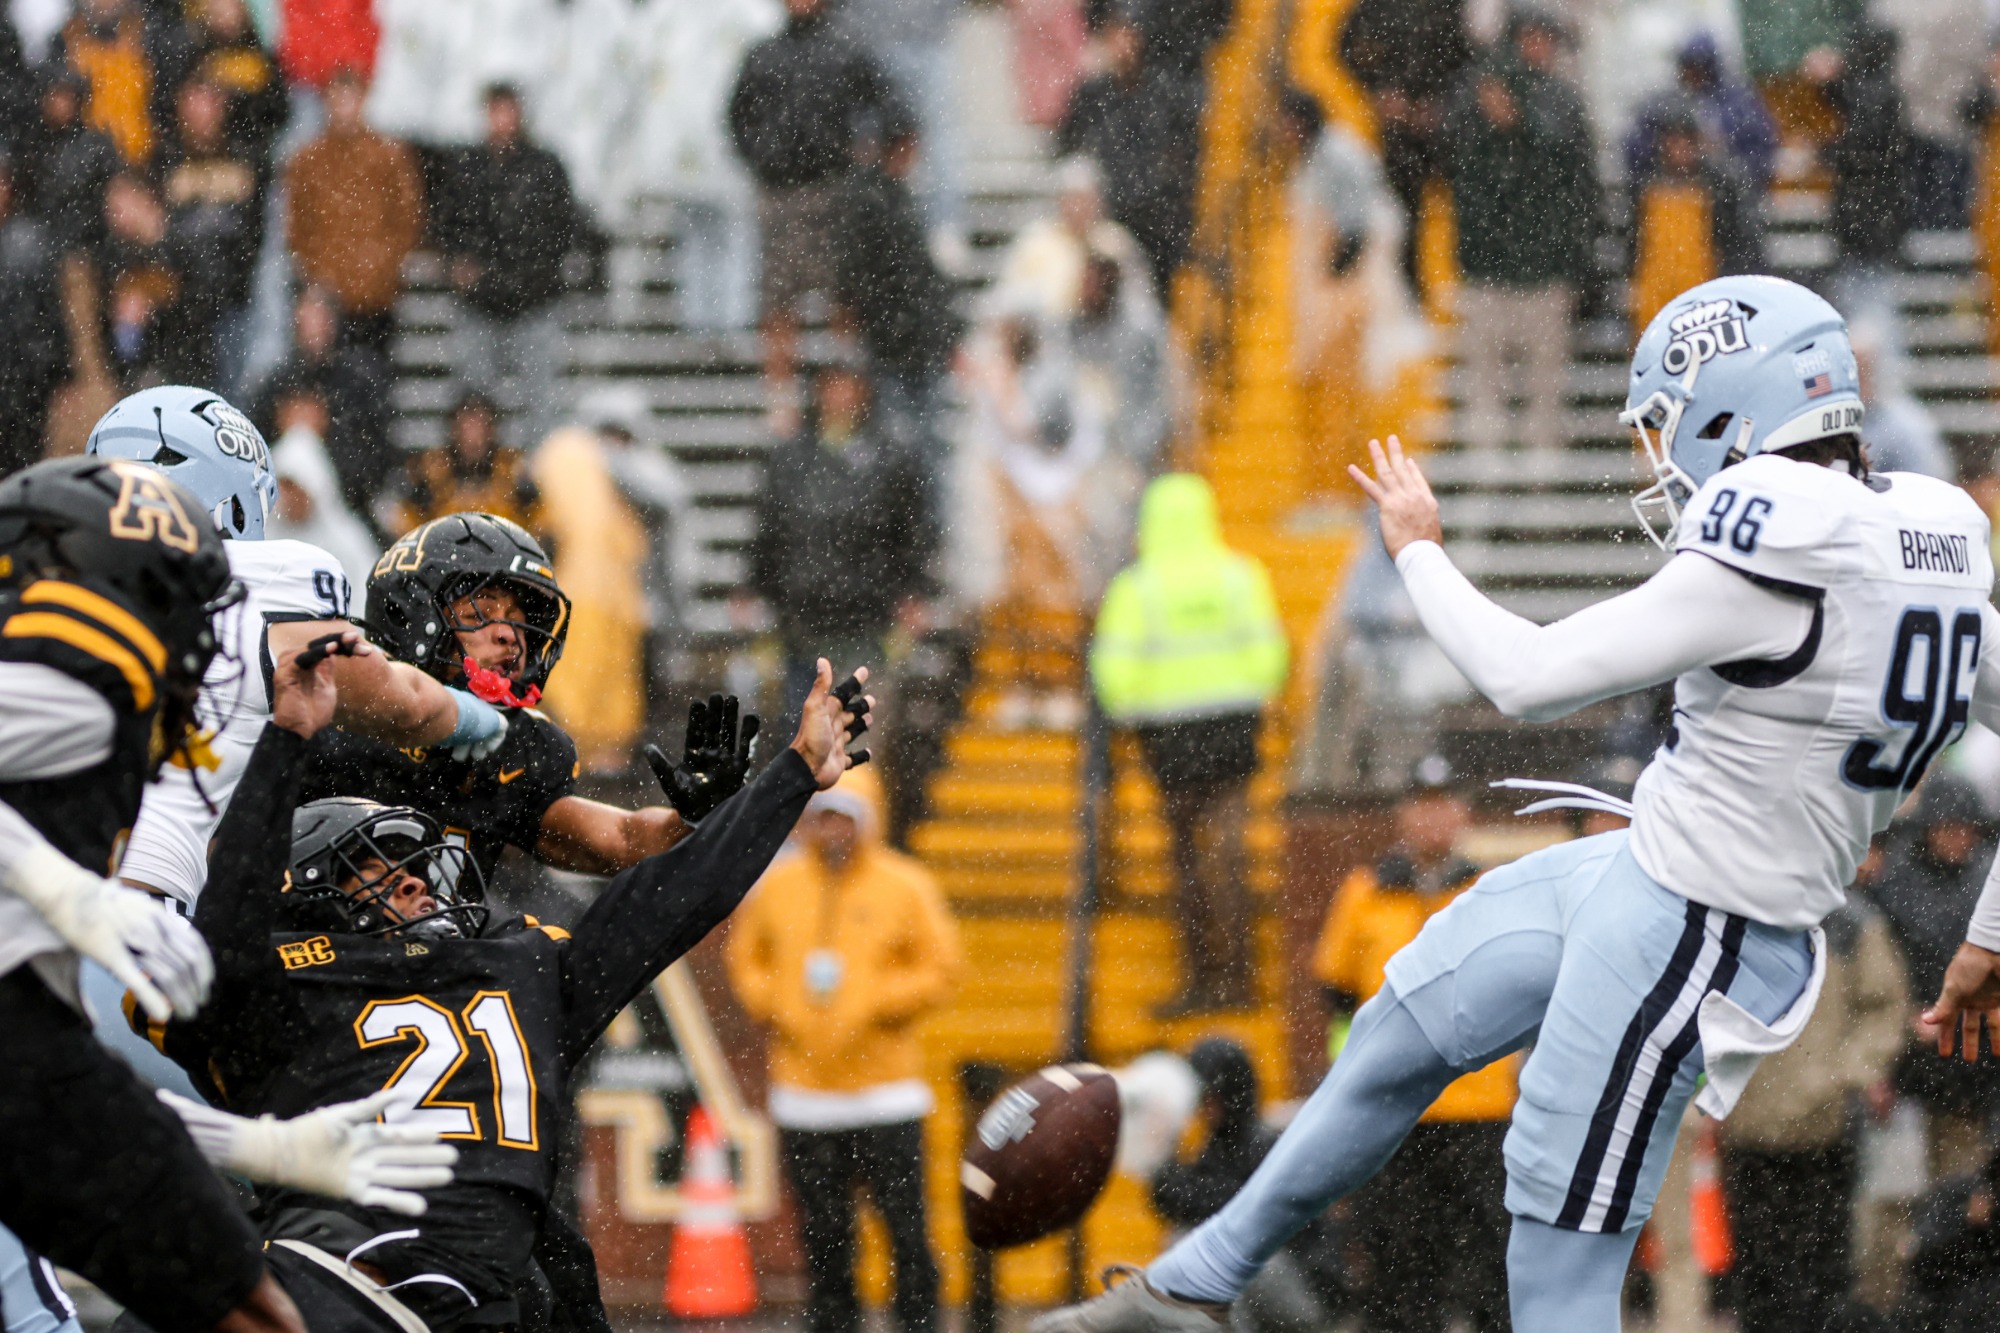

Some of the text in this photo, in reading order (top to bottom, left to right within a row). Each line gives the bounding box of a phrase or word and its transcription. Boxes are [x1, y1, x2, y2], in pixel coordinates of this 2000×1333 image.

[1662, 316, 1751, 376] ODU
[1822, 410, 1841, 432] OLD
[214, 424, 269, 473] ODU
[1701, 487, 1776, 557] 96
[1898, 528, 1971, 576] BRANDT
[1839, 604, 1981, 793] 96
[276, 935, 337, 971] BC
[353, 989, 540, 1151] 21
